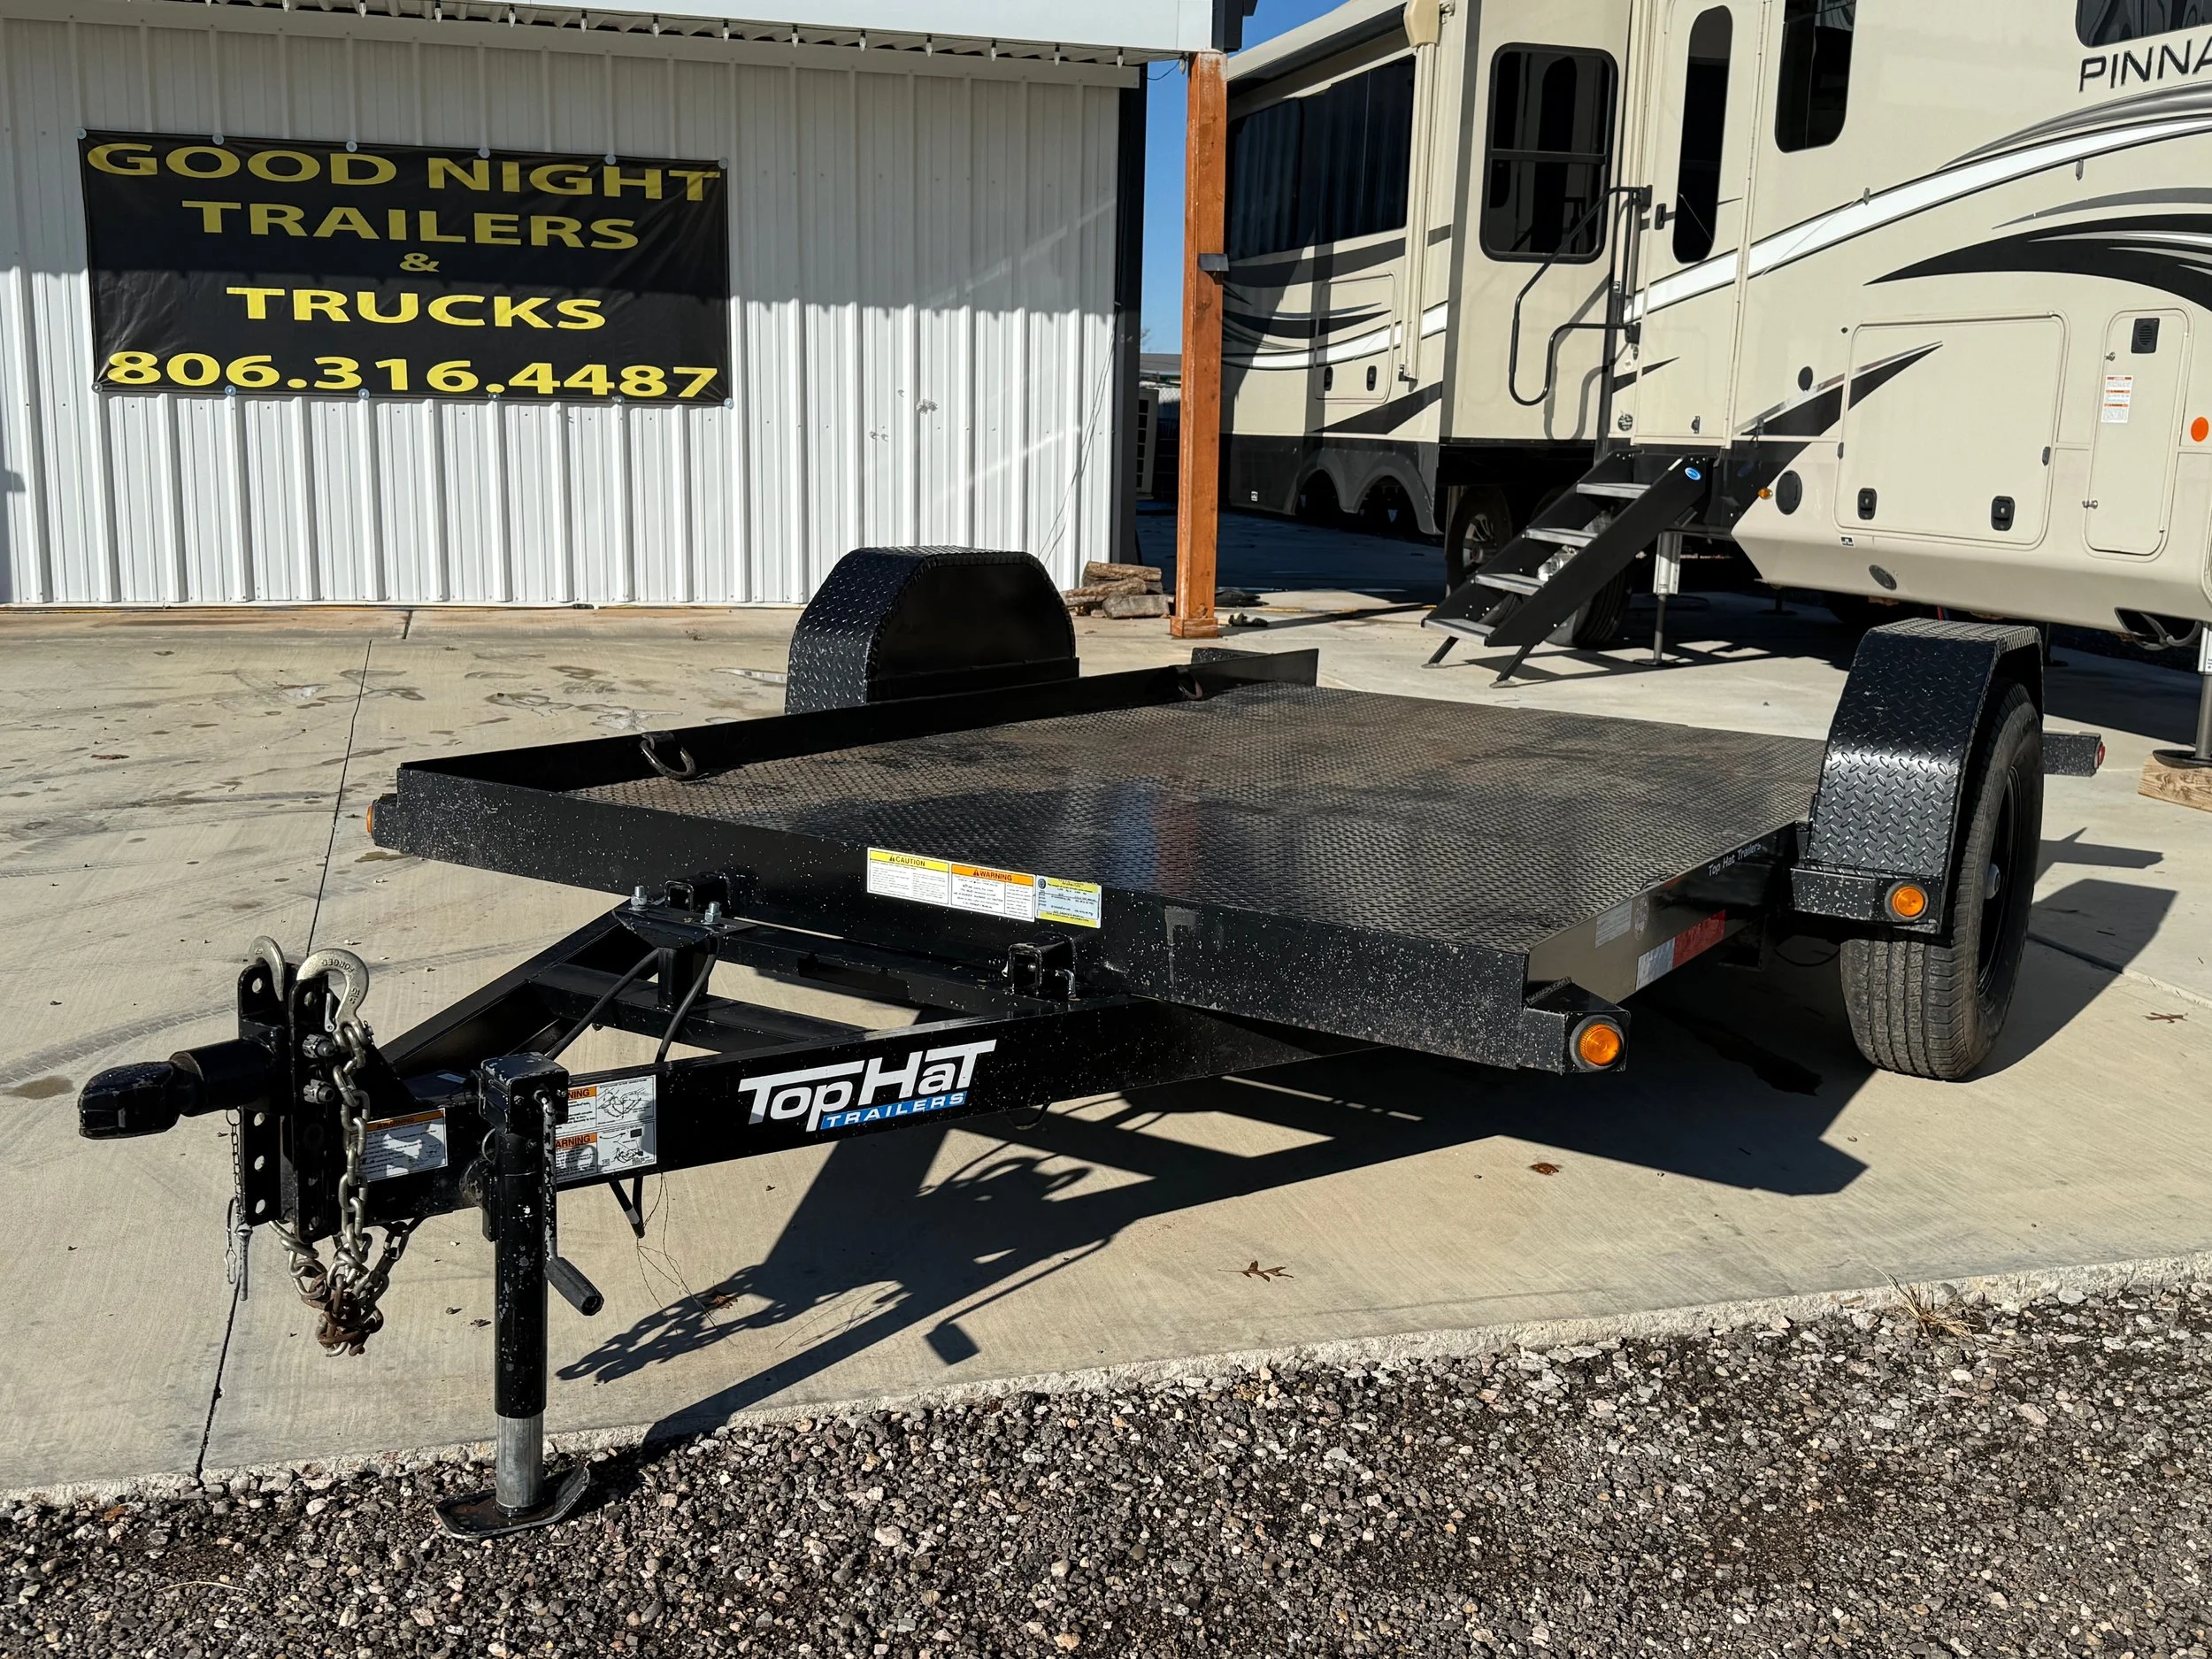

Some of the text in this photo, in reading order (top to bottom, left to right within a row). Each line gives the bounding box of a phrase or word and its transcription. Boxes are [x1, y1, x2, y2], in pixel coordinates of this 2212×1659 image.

[88, 142, 721, 202] GOOD NIGHT
[181, 200, 638, 250] TRAILERS
[398, 252, 440, 273] &
[227, 286, 607, 331] TRUCKS
[106, 351, 718, 398] 806.316.4487
[895, 856, 926, 867] CAUTION
[1708, 863, 1721, 877] Top
[979, 870, 1012, 882] WARNING
[826, 1092, 965, 1128] TRAILERS
[556, 1135, 590, 1147] ARNING
